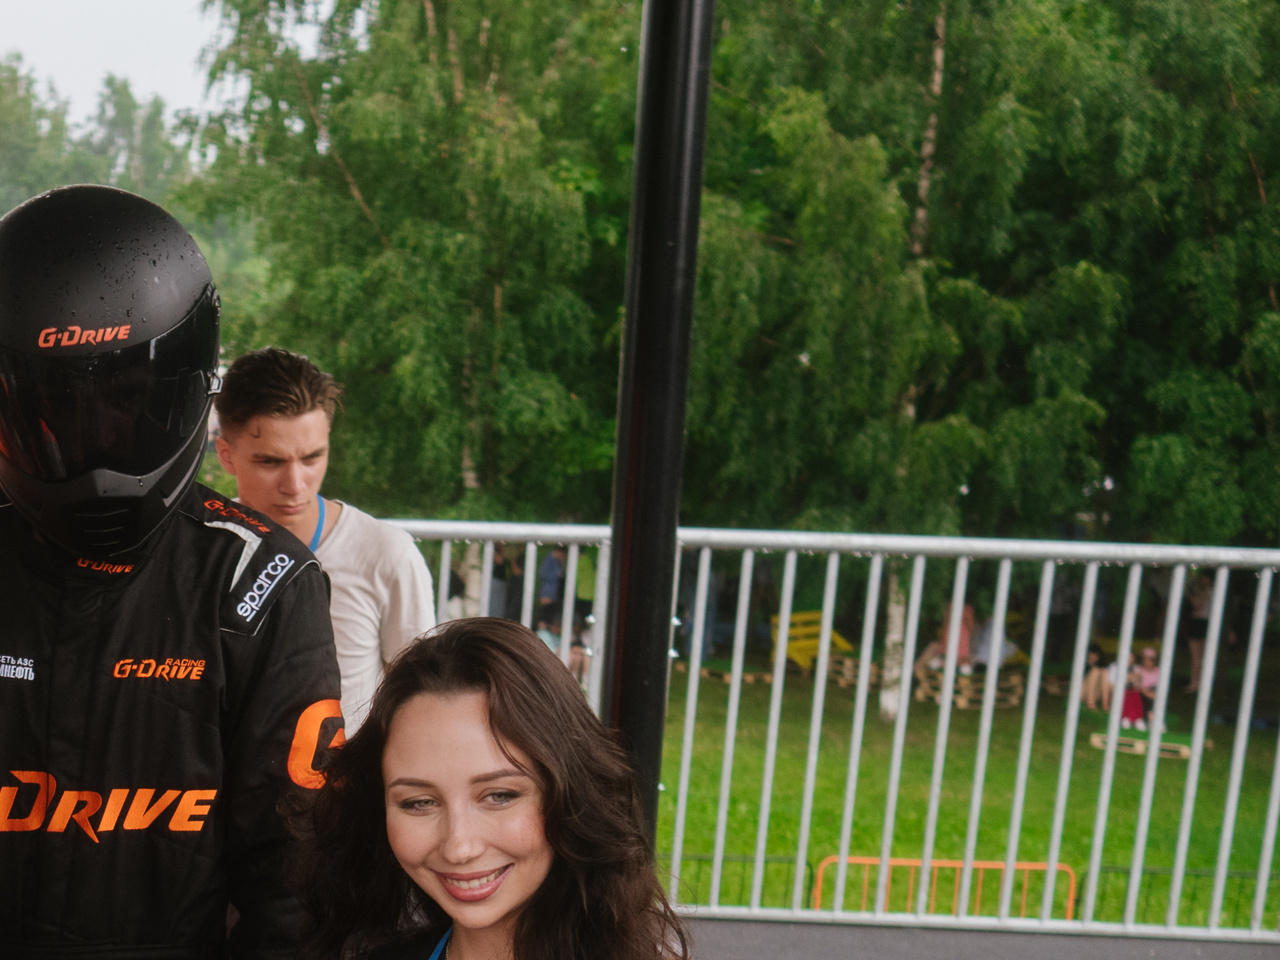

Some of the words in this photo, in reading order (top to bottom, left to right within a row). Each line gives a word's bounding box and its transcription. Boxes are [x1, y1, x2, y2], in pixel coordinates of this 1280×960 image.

[237, 553, 294, 622] sparco
[16, 657, 34, 667] АЗС
[164, 658, 206, 667] RACING
